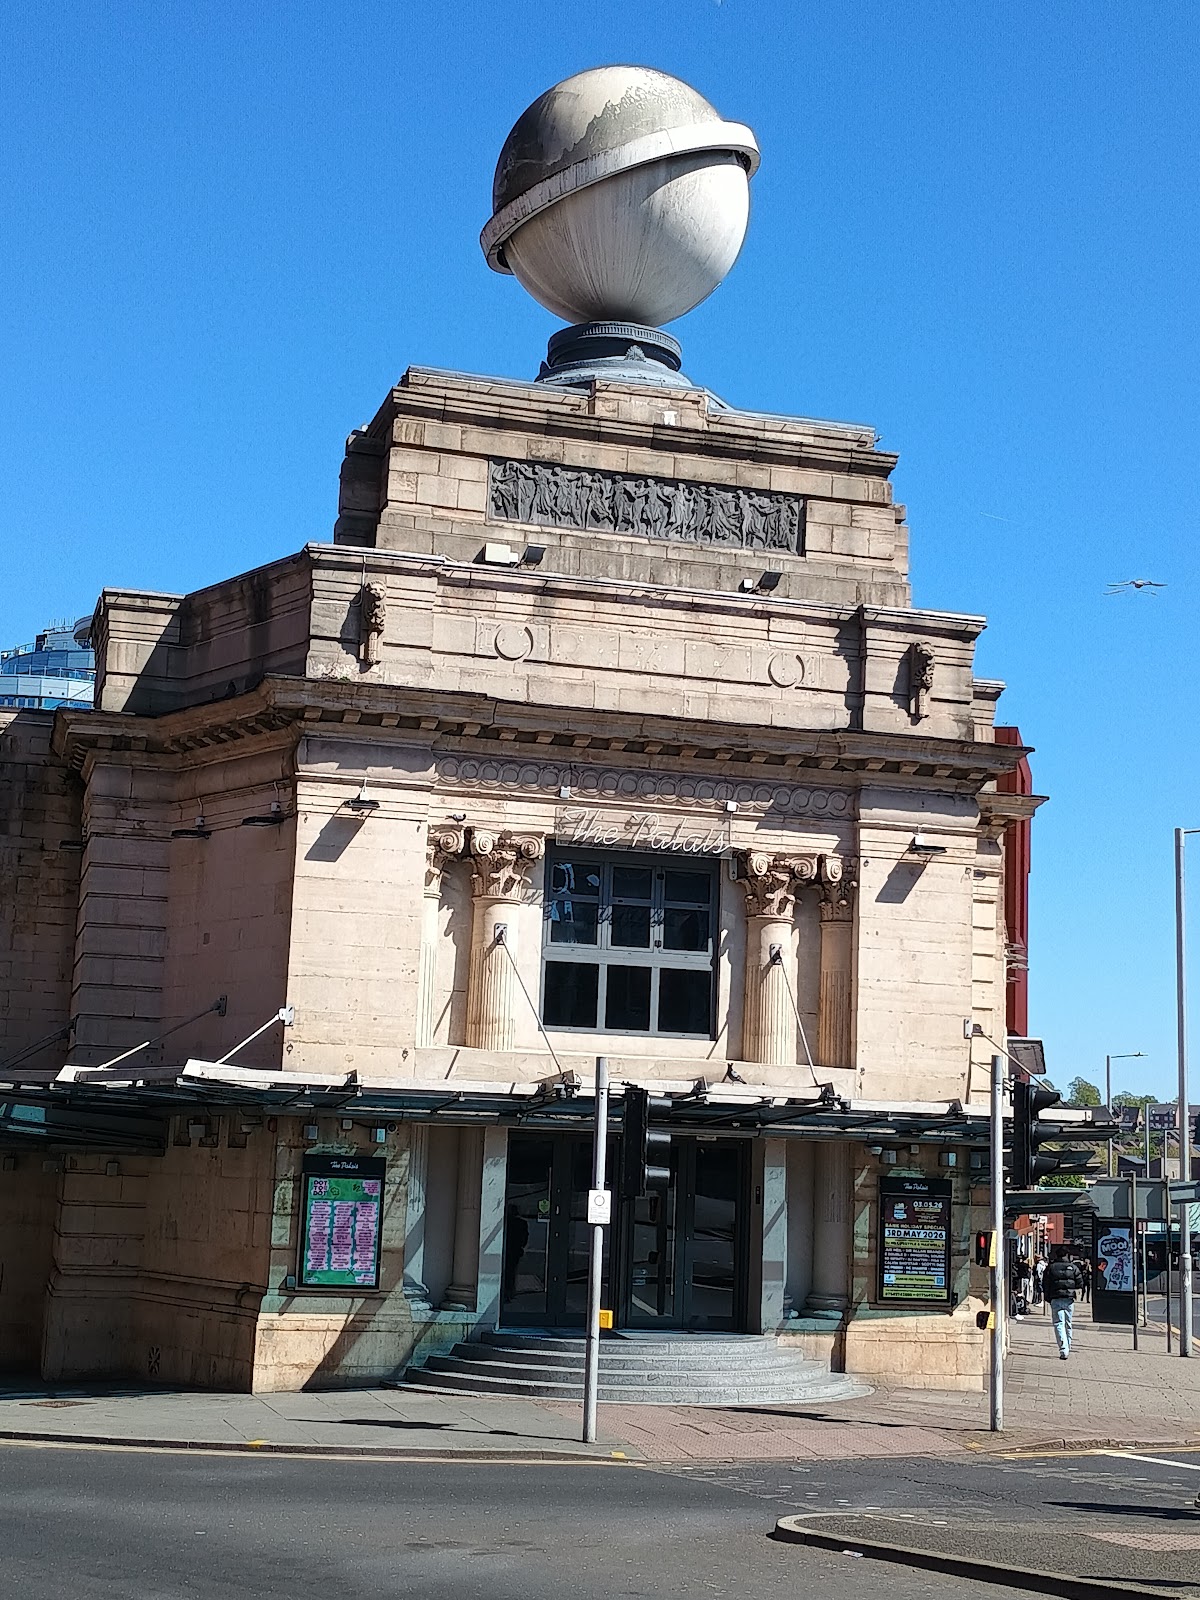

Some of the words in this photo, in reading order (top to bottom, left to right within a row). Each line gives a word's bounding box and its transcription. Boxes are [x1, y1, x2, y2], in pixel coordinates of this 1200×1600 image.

[565, 808, 621, 845] The
[628, 811, 732, 855] Palais
[341, 1161, 359, 1170] Palais
[887, 1229, 902, 1237] 3RD
[903, 1230, 922, 1238] MAY
[922, 1231, 944, 1239] 2026
[1101, 1241, 1127, 1252] MOO!
